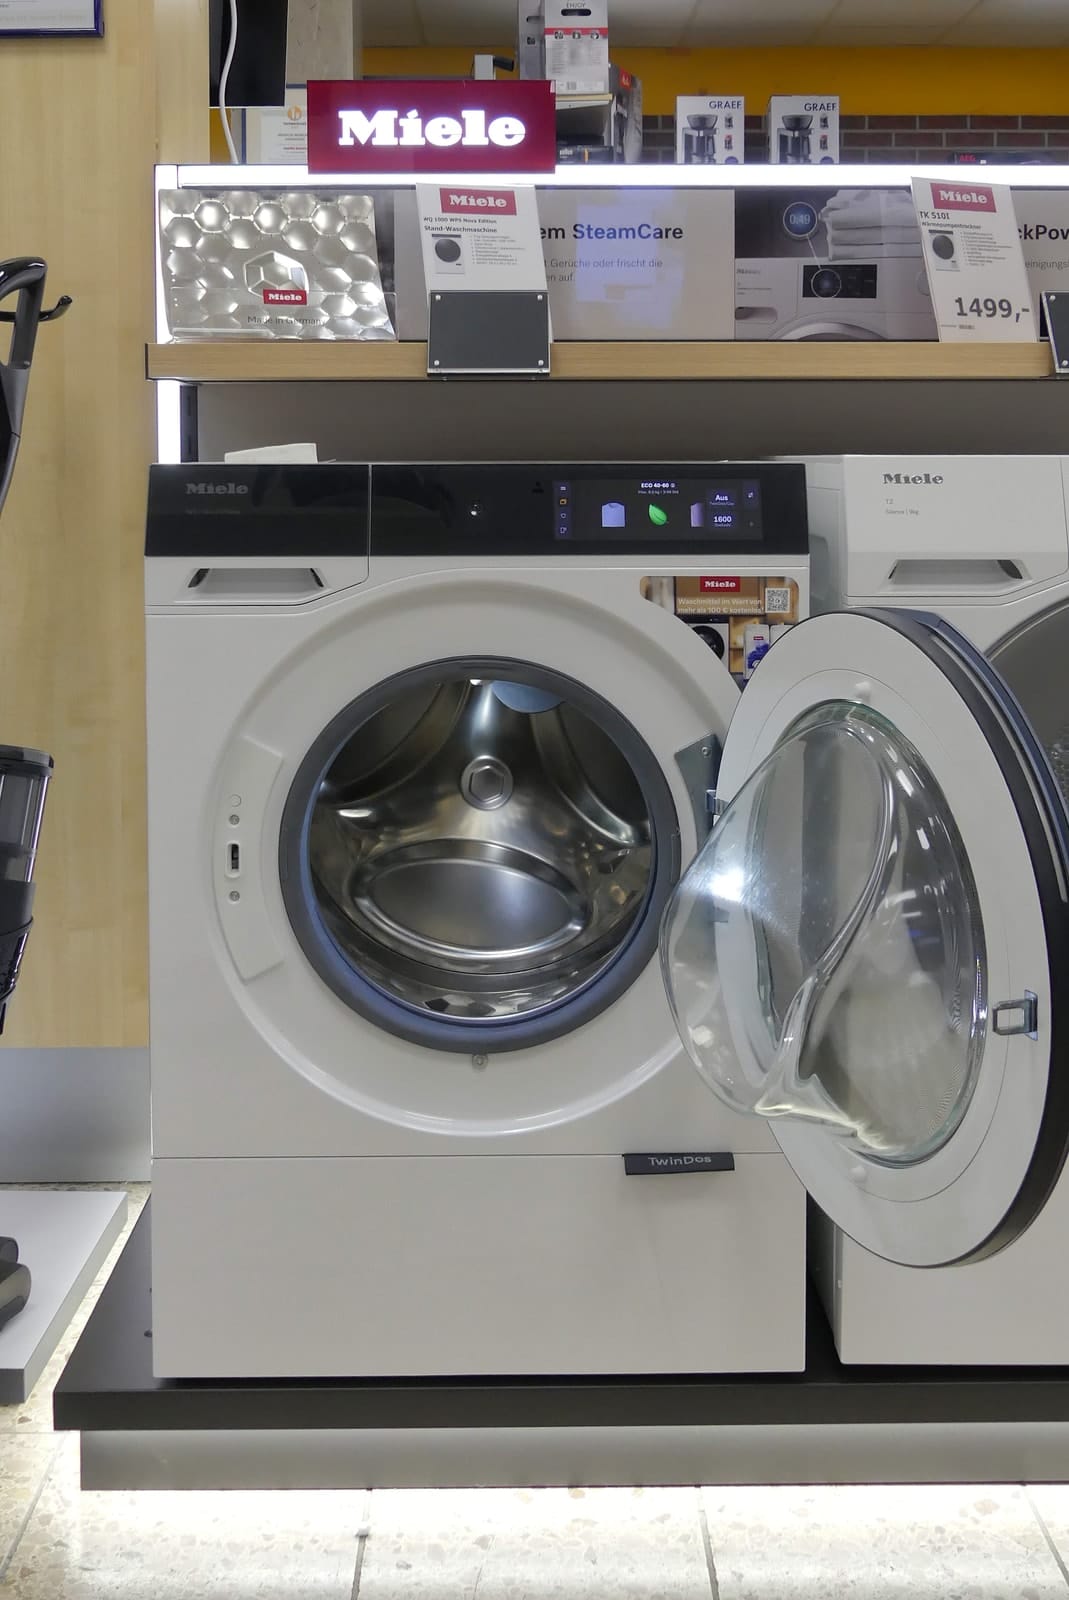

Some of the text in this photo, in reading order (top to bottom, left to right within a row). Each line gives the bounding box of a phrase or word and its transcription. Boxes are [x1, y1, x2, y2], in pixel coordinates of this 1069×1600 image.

[708, 100, 742, 110] GRAEF
[803, 102, 837, 112] GRAEF
[337, 109, 527, 147] Miele
[449, 194, 507, 208] Miele
[939, 190, 988, 204] Miele
[572, 223, 684, 240] SteamCare
[592, 258, 615, 268] oder
[616, 258, 646, 268] frischt
[648, 258, 663, 268] die
[1024, 259, 1069, 271] einigungs
[268, 293, 302, 301] Miele
[955, 296, 1030, 323] 1499,-
[883, 473, 944, 485] Miele
[186, 482, 248, 495] Miele
[713, 515, 732, 523] 1600
[704, 580, 737, 588] Miele
[707, 606, 721, 614] 100
[648, 1155, 712, 1167] TwinDos
